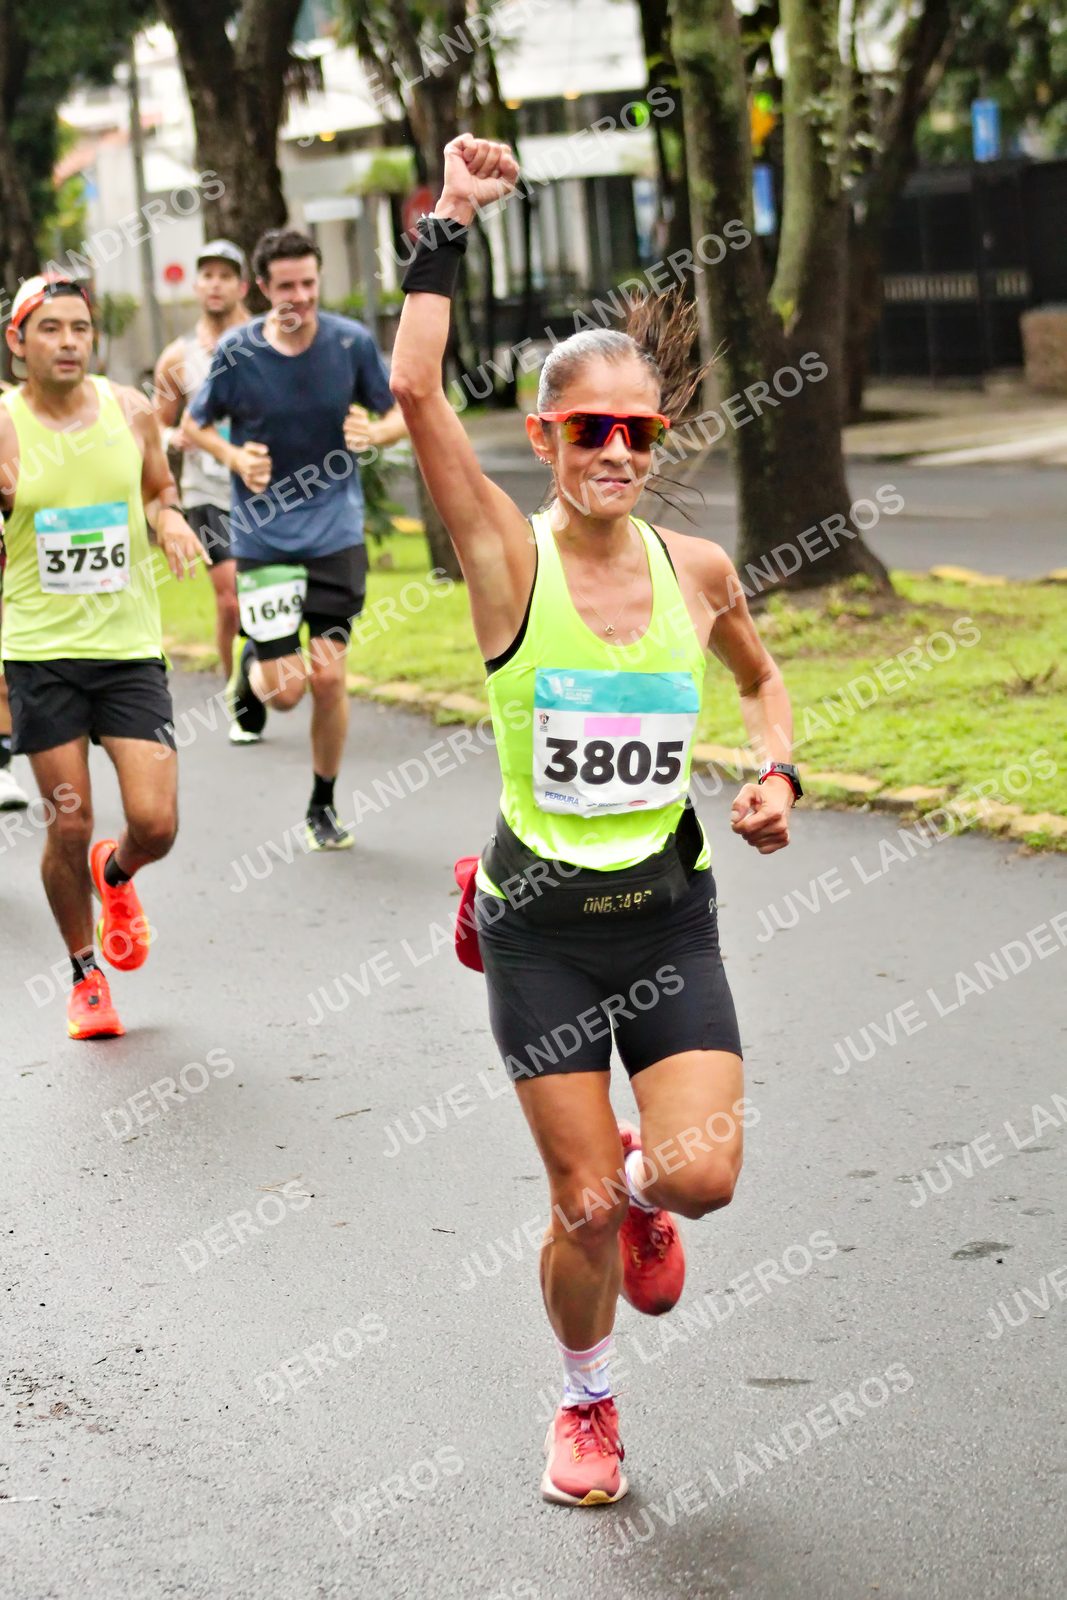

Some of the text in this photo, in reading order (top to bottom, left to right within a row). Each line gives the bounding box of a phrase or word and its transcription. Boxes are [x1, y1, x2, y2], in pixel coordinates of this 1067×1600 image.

[45, 542, 125, 574] 3736
[248, 594, 303, 624] 1649
[544, 737, 684, 785] 3805
[545, 791, 579, 805] PERDURA
